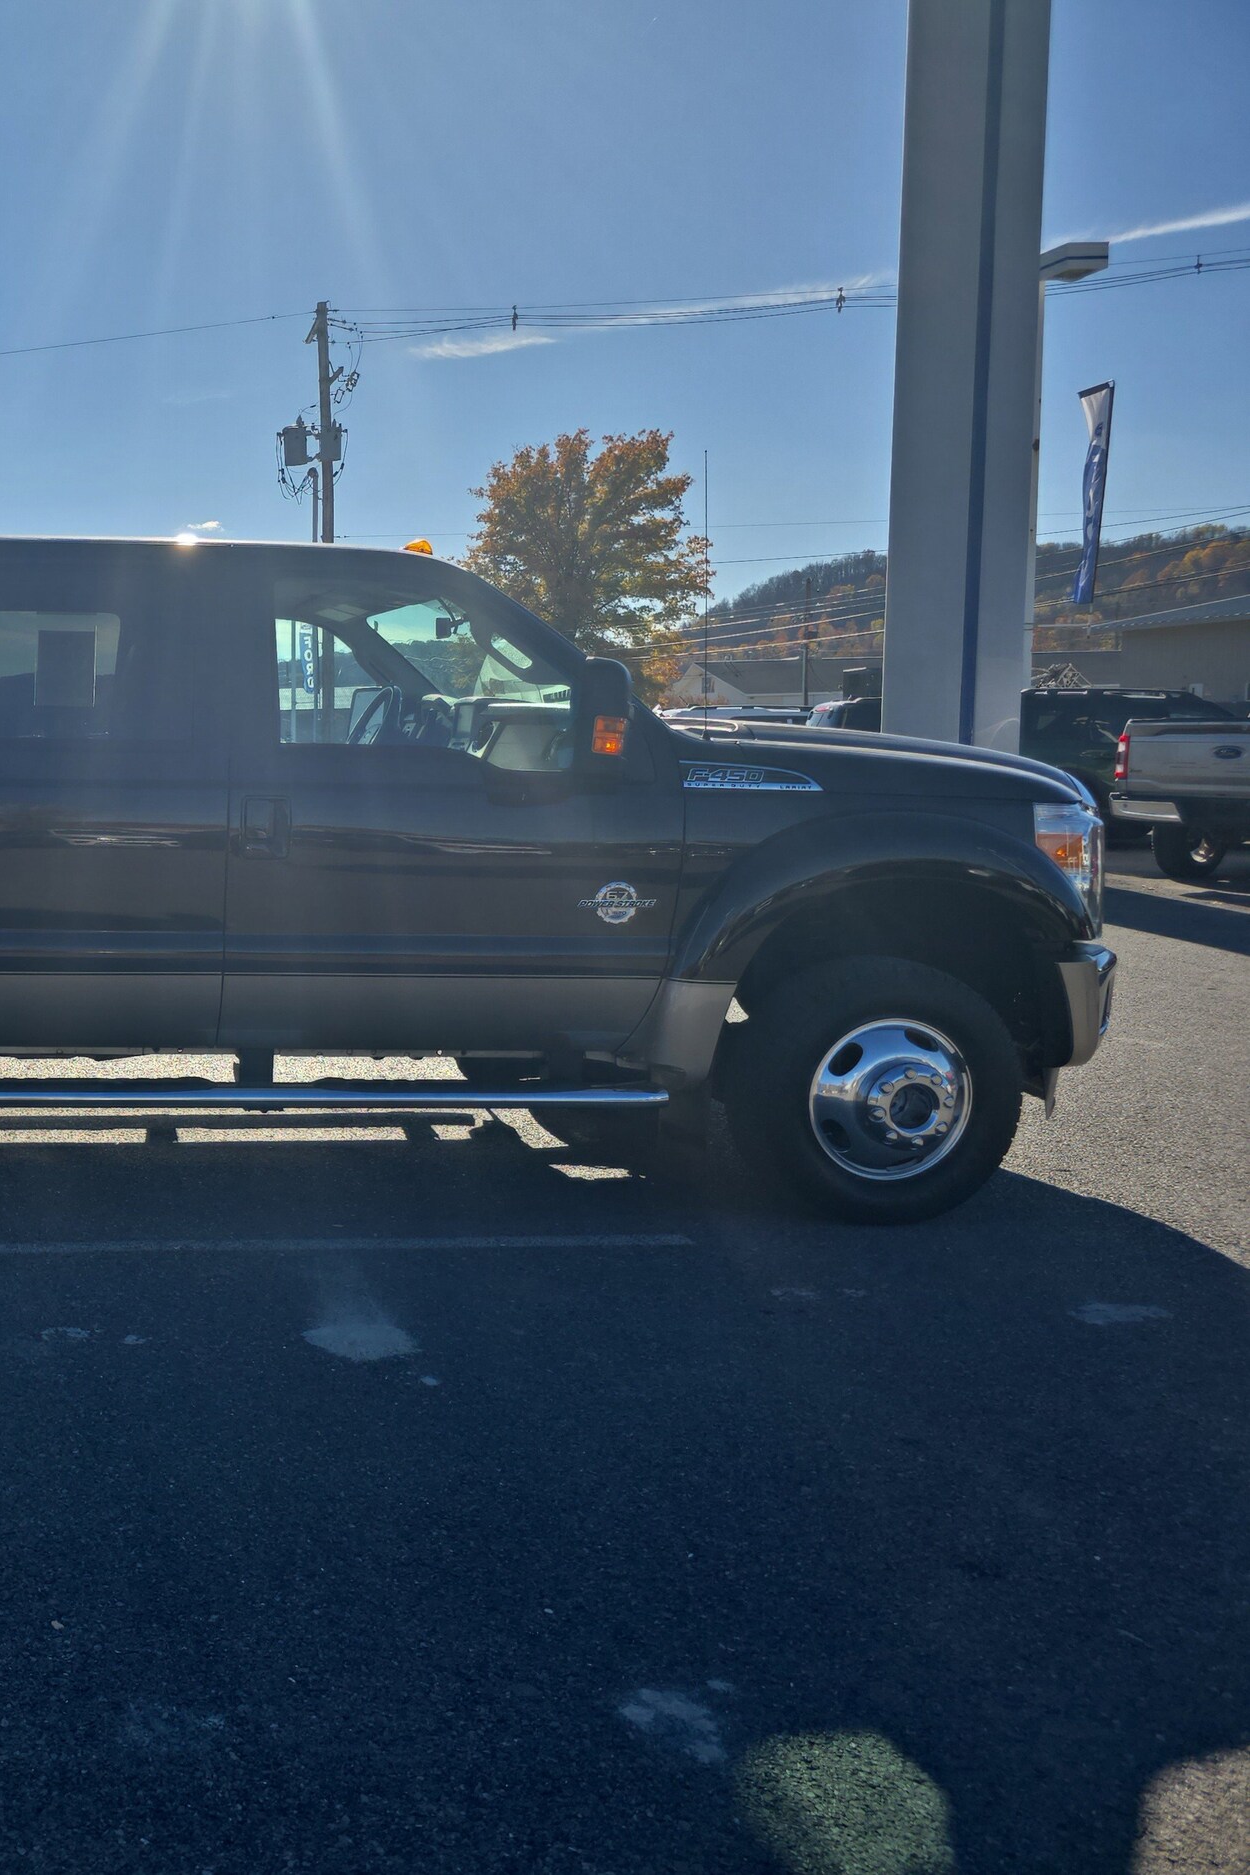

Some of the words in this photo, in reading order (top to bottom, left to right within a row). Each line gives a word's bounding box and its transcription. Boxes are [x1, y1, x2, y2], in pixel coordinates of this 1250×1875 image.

[687, 768, 764, 782] F-450
[576, 900, 614, 908] POWER
[615, 900, 657, 908] STROKE
